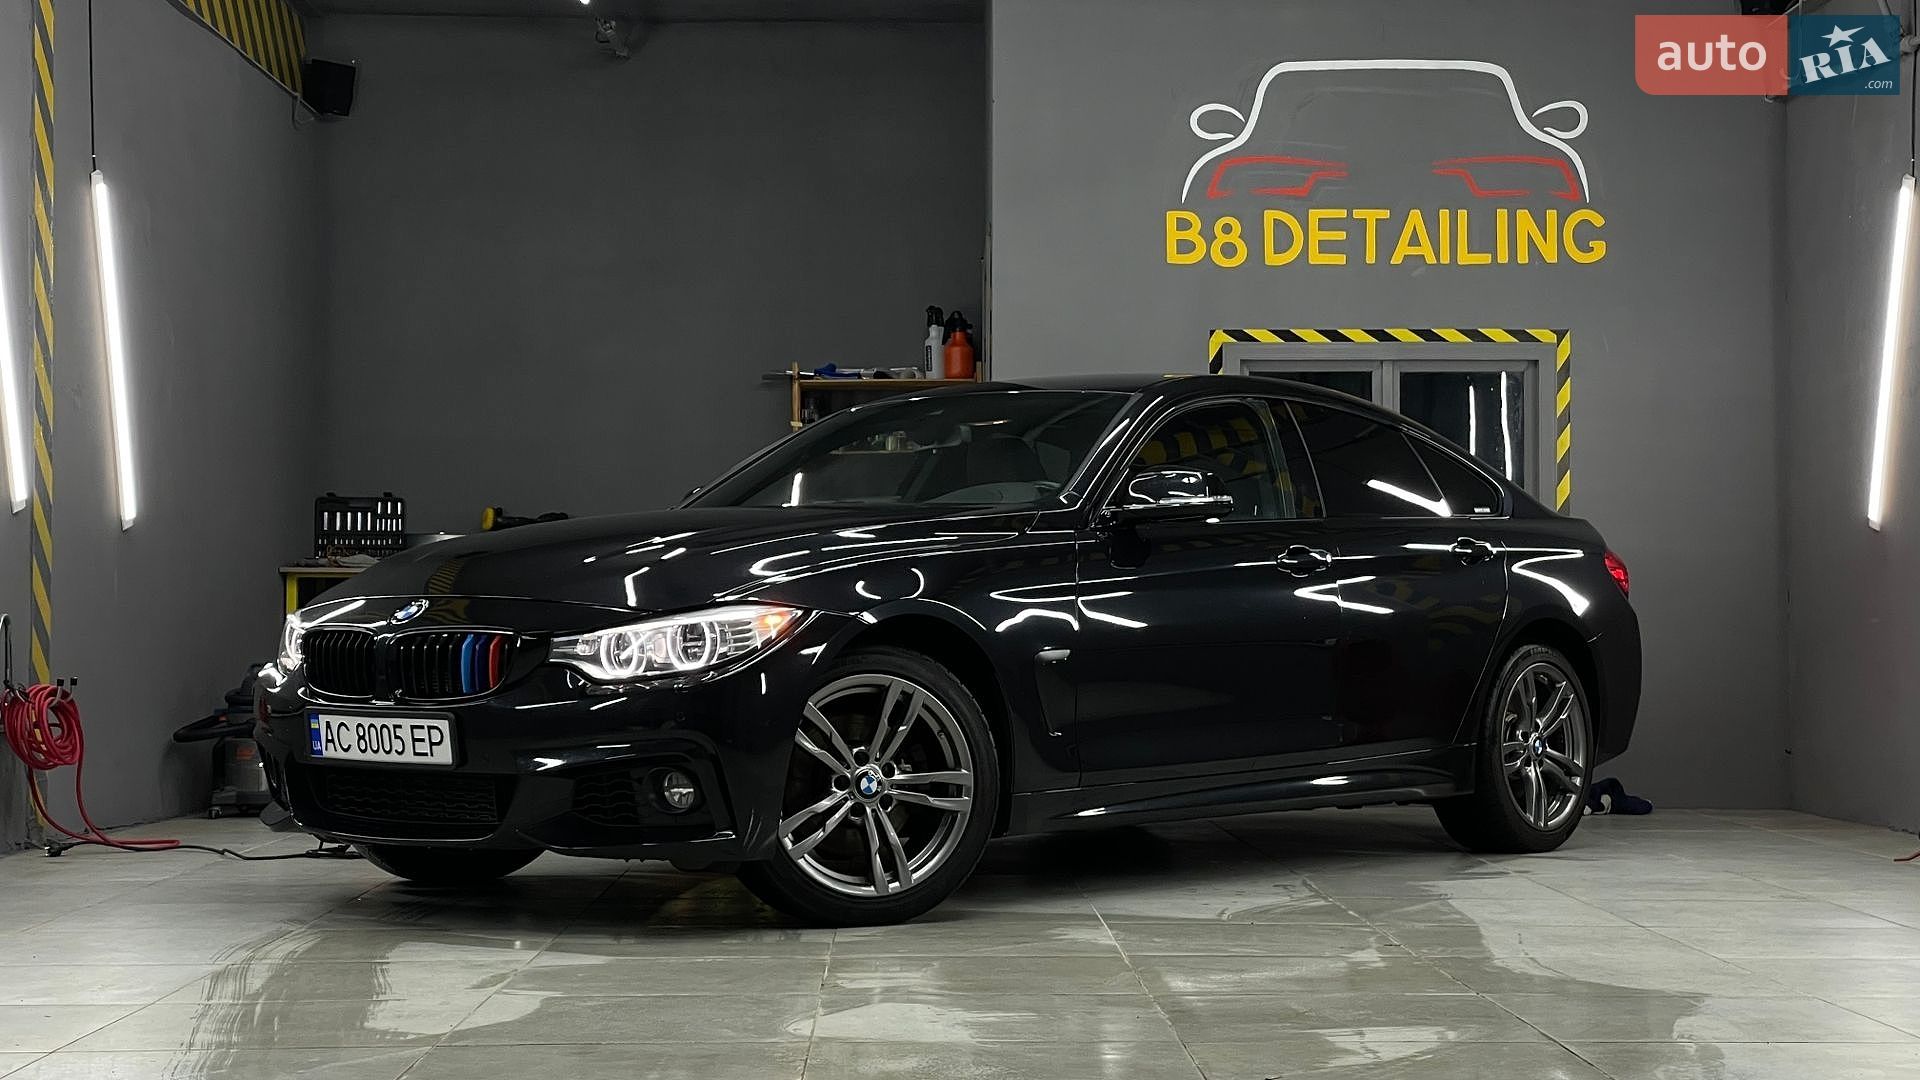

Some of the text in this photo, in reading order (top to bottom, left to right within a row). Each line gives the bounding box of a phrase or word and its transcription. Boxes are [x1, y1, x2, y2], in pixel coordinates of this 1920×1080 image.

[1165, 208, 1608, 268] B8 DETAILING
[324, 720, 445, 757] AC 8005 EP
